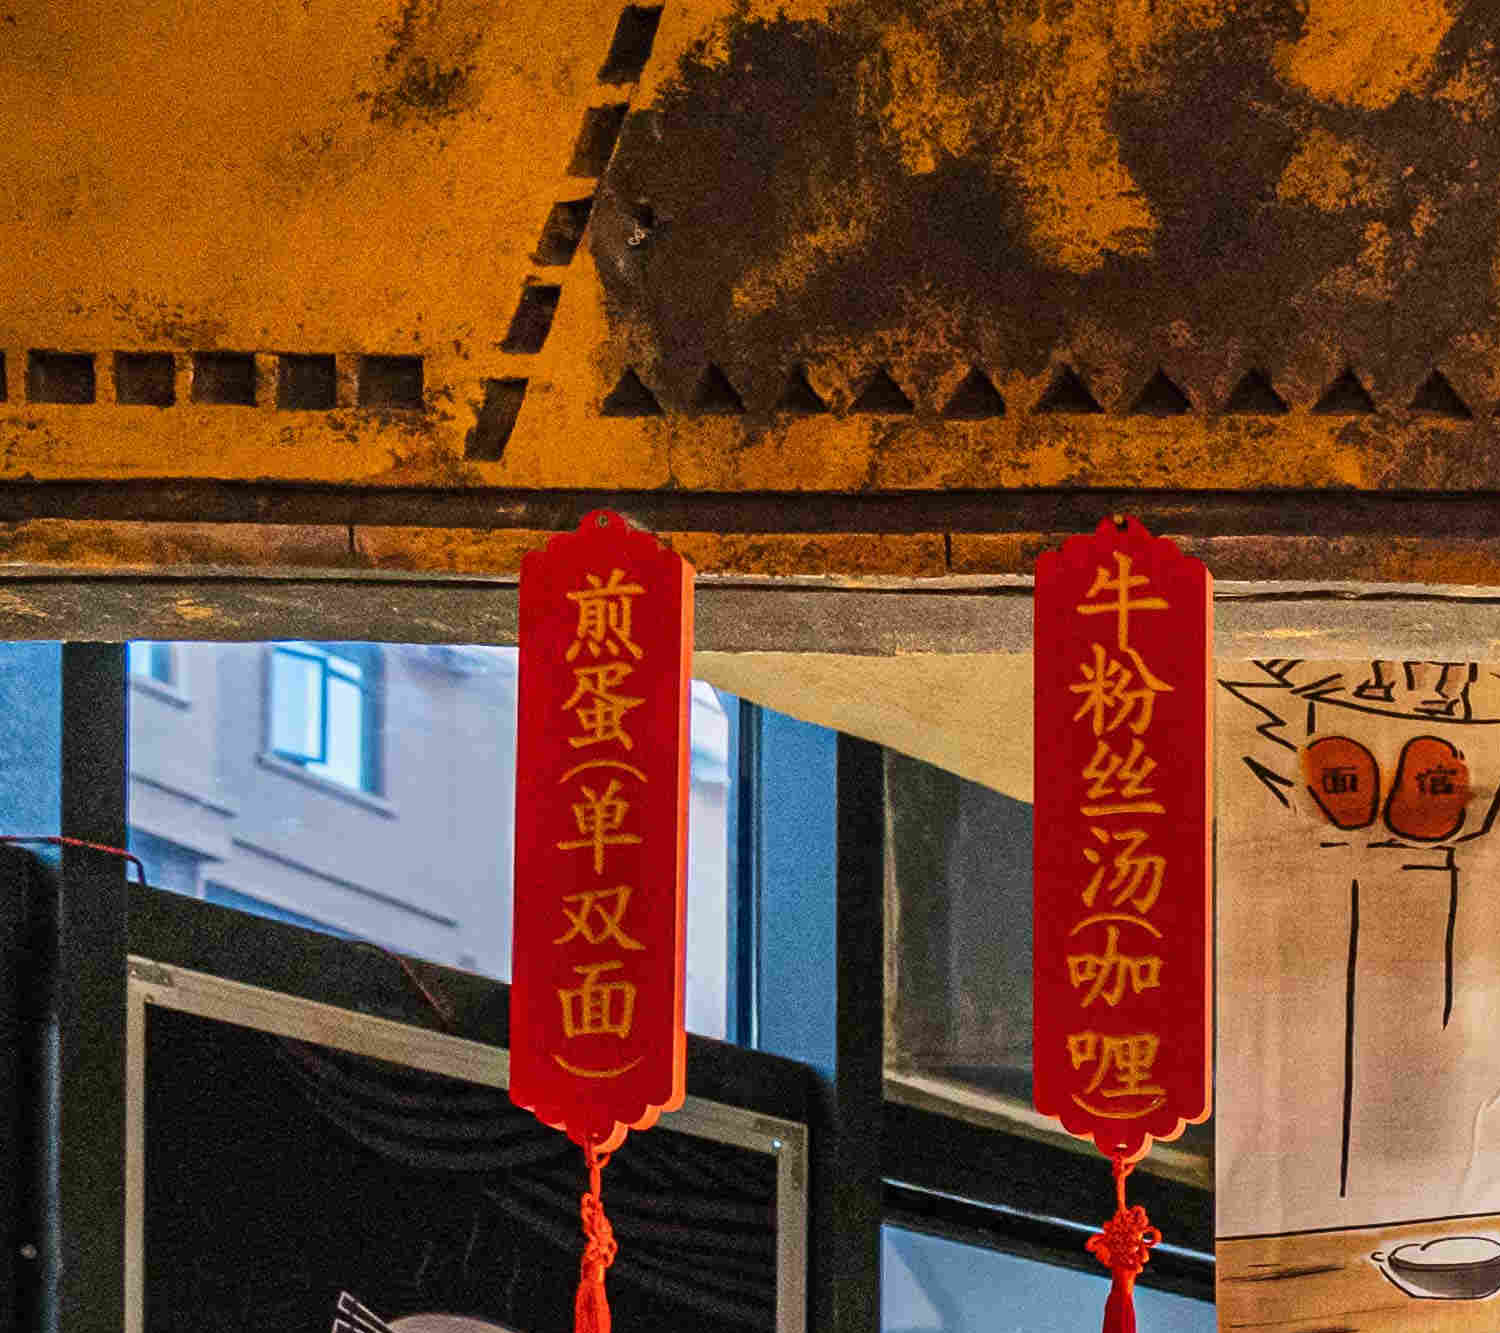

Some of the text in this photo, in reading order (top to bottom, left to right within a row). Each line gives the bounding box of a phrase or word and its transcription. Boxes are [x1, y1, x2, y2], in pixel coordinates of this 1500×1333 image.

[553, 568, 646, 1080] 煎蛋（单双面）
[1065, 551, 1175, 1119] 牛粉丝汤（咖喱）
